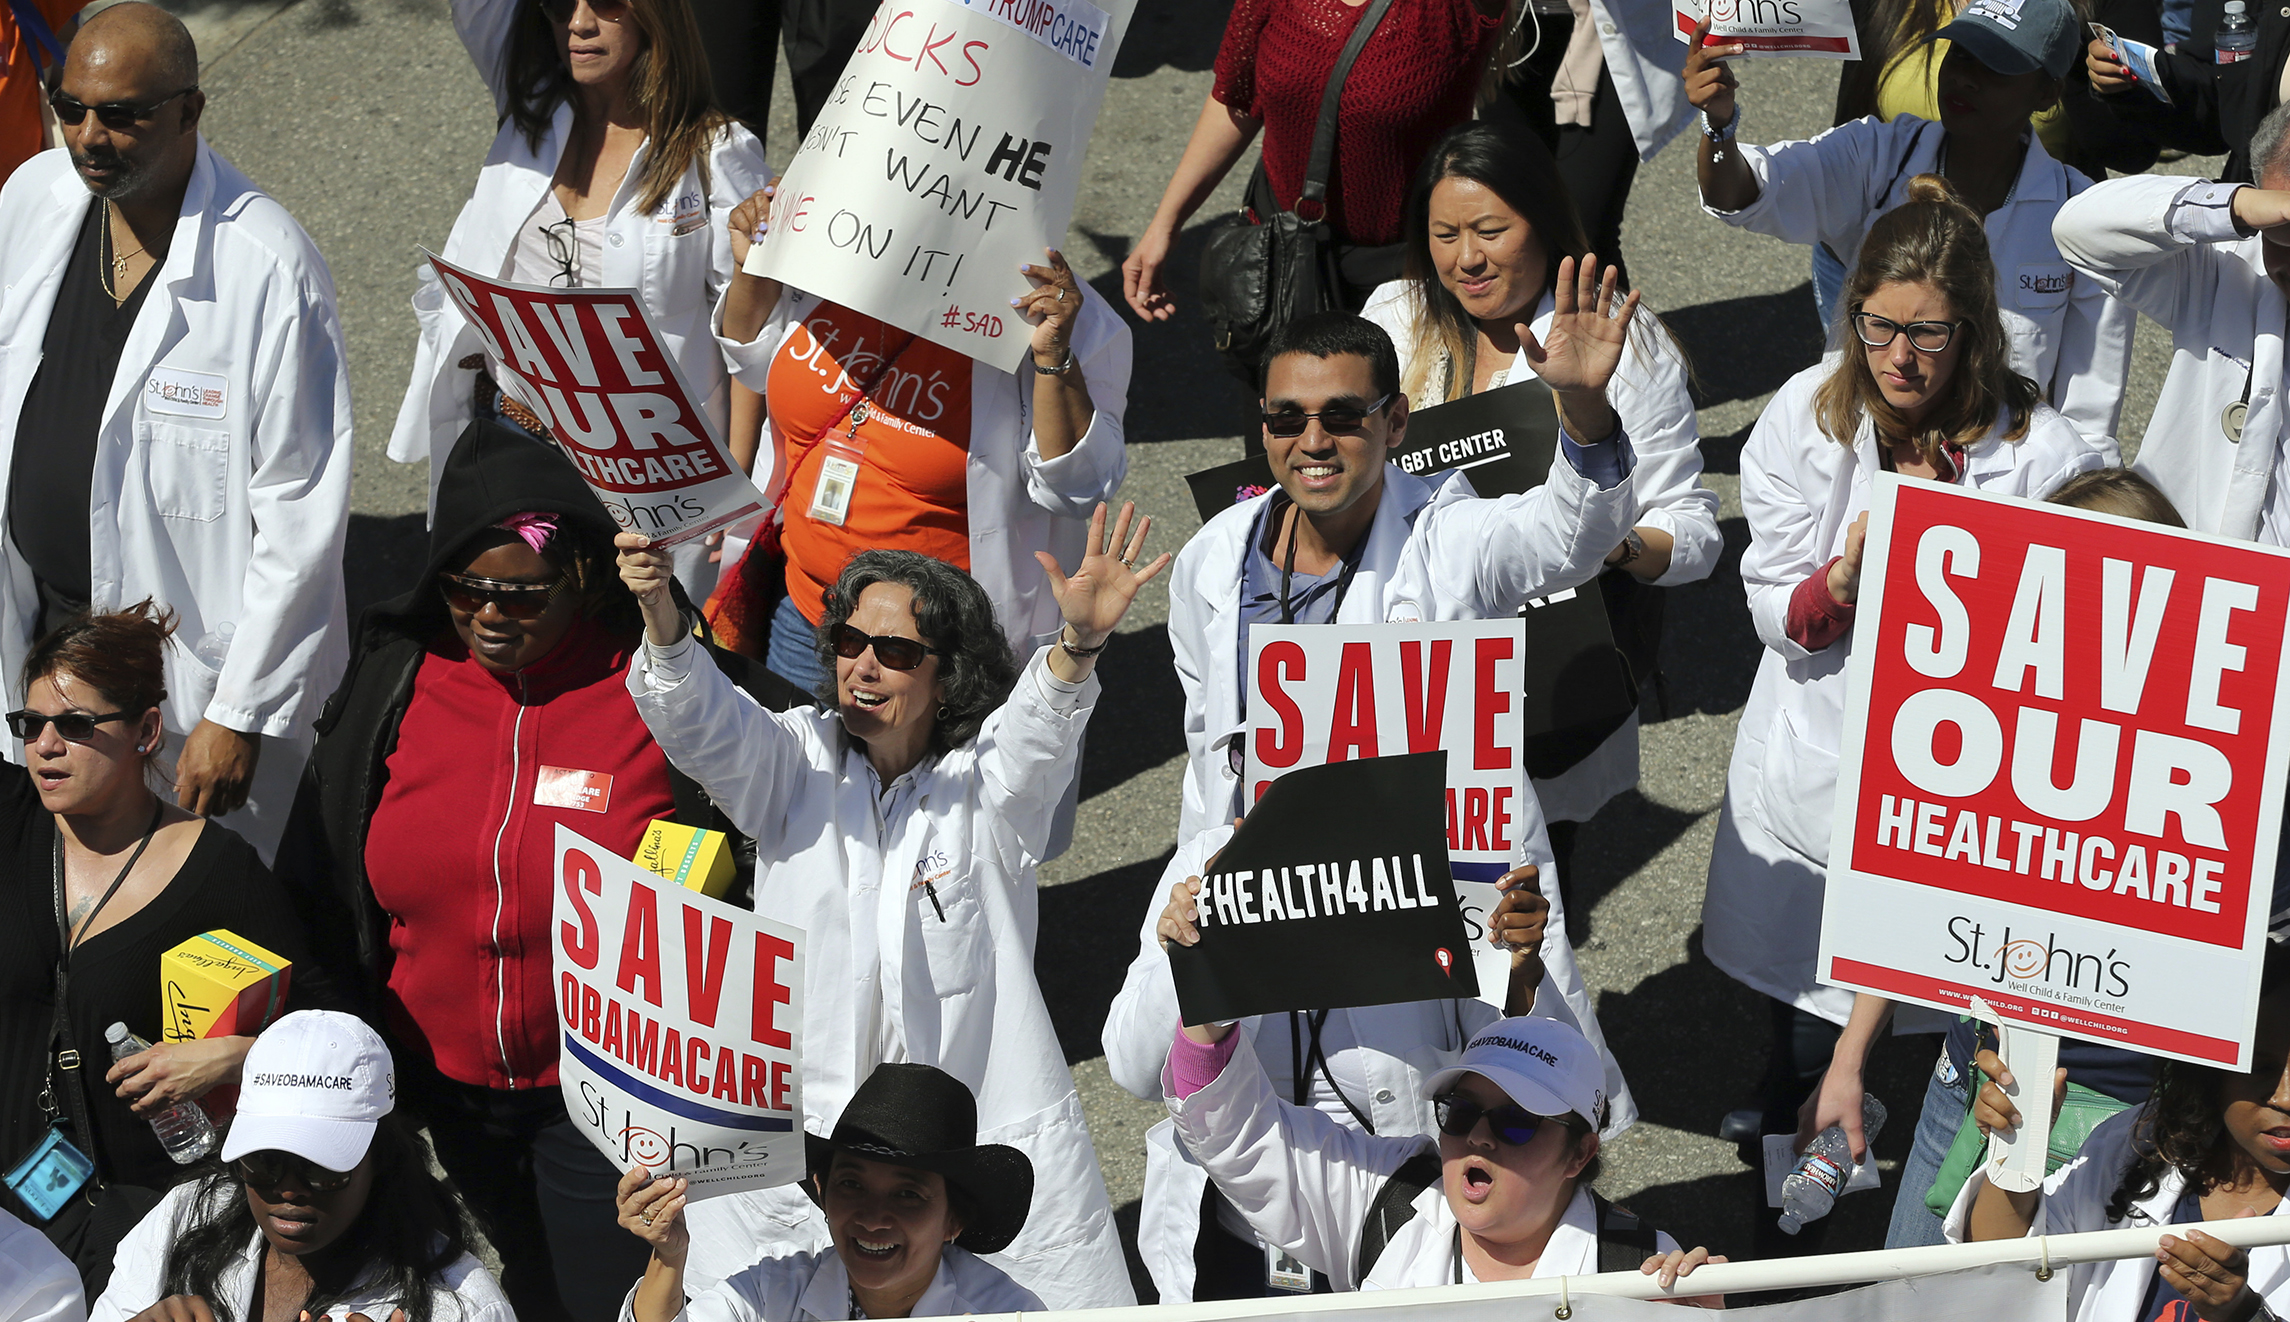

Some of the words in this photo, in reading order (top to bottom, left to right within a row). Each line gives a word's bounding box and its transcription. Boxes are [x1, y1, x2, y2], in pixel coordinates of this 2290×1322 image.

[1713, 23, 1727, 32] Well
[1728, 25, 1747, 33] Child
[863, 81, 981, 162] EVEN
[985, 132, 1052, 191] HE
[887, 147, 1018, 231] WANT
[828, 208, 892, 259] ON
[903, 245, 963, 297] IT!
[2020, 275, 2034, 289] St.
[443, 271, 665, 387] SAVE
[941, 304, 1003, 338] #SAD
[789, 319, 841, 376] St.
[148, 378, 161, 395] St.
[161, 381, 199, 400] John's
[881, 412, 904, 431] Family
[904, 421, 936, 438] Center
[1438, 428, 1508, 464] CENTER
[564, 444, 718, 486] LTHCARE
[596, 490, 706, 530] ohn's
[658, 525, 683, 537] Family
[684, 515, 710, 528] Center
[1903, 524, 2260, 735] SAVE
[1255, 637, 1514, 770] SAVE
[1891, 687, 2233, 852] OUR
[680, 841, 699, 874] BASKETS
[1876, 794, 2226, 914] HEALTHCARE
[1196, 852, 1439, 928] #HEALTH4ALL
[560, 848, 795, 1050] SAVE
[1944, 916, 1991, 970] St.
[1991, 926, 2131, 998] John's
[164, 980, 210, 1043] Ing
[1938, 988, 2024, 1012] WWW.WCHILD.ORG
[2060, 1015, 2128, 1035] @WELLCHILDORG
[2007, 980, 2028, 993] Well
[2029, 985, 2053, 998] Child
[2054, 990, 2061, 1000] &
[2063, 992, 2093, 1008] Family
[2094, 999, 2126, 1013] Center
[562, 971, 793, 1112] OBAMACARE
[1467, 1035, 1559, 1068] #SAVEOBAMACARE
[253, 1073, 353, 1091] #SAVEOBAMACARE
[580, 1080, 617, 1146] St.
[617, 1110, 769, 1171] John's
[688, 1172, 766, 1186] @WELLCHILDORG
[694, 1164, 728, 1176] Family
[731, 1160, 768, 1171] Center
[1803, 1162, 1837, 1186] ARROWHEAD
